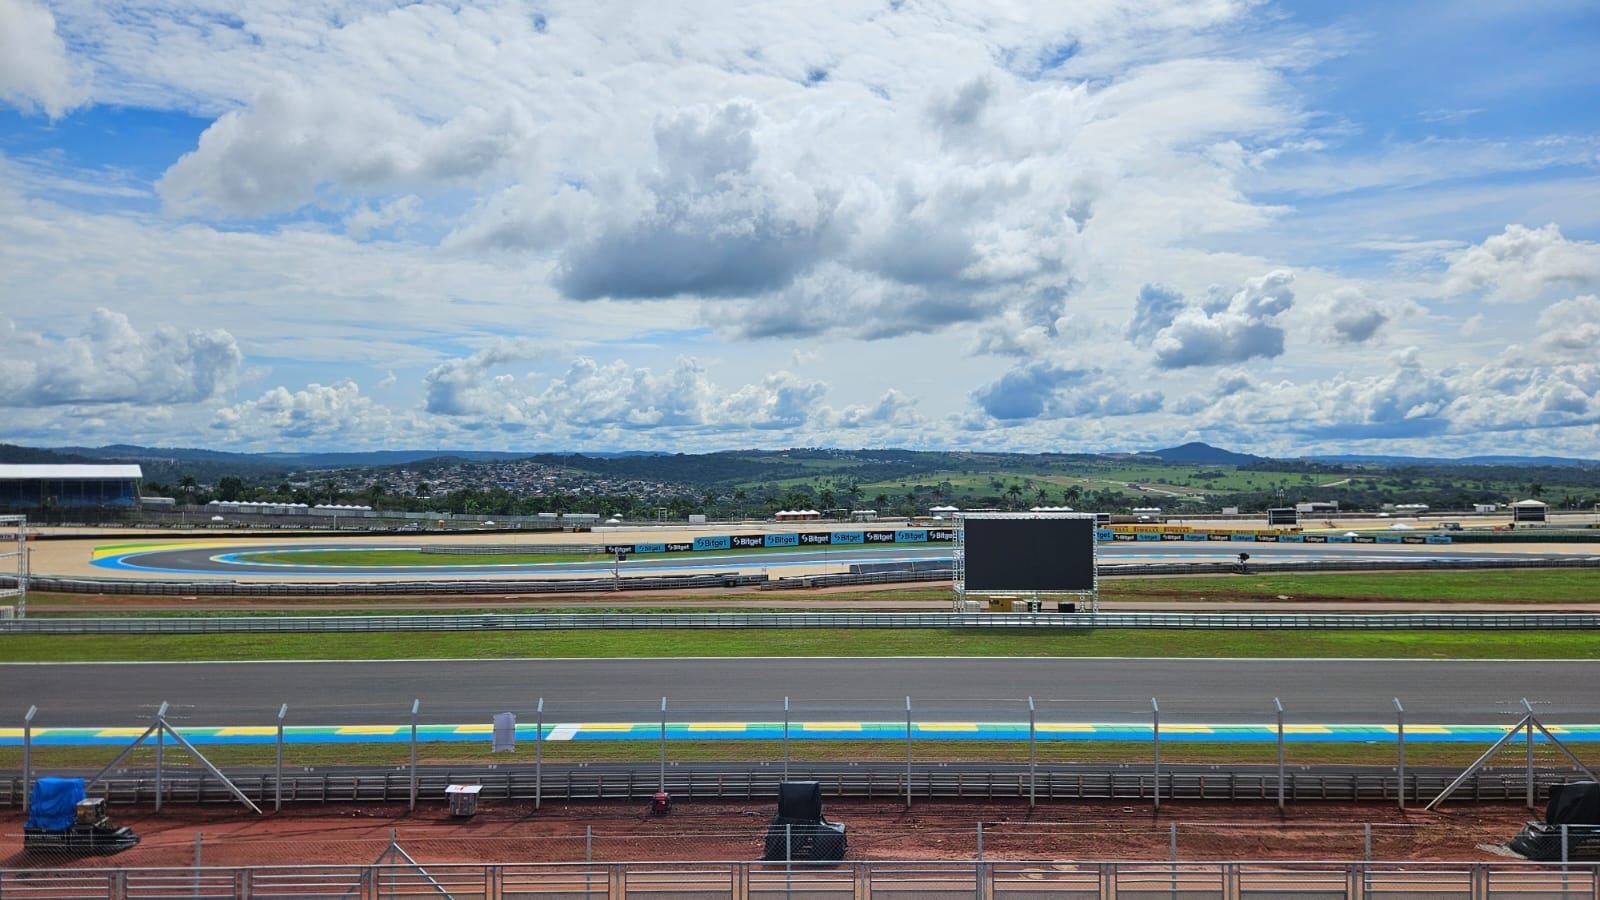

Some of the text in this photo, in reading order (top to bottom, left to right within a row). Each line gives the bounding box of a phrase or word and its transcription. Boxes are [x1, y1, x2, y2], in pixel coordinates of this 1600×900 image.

[808, 534, 829, 543] Bitget
[840, 534, 860, 542] Bitget
[873, 533, 893, 541] Bitget
[904, 532, 924, 541] Bitget
[936, 531, 953, 540] Bitge
[1097, 531, 1110, 539] tget
[704, 539, 727, 548] Bitget
[740, 537, 762, 546] Bitget
[774, 536, 796, 545] Bitget
